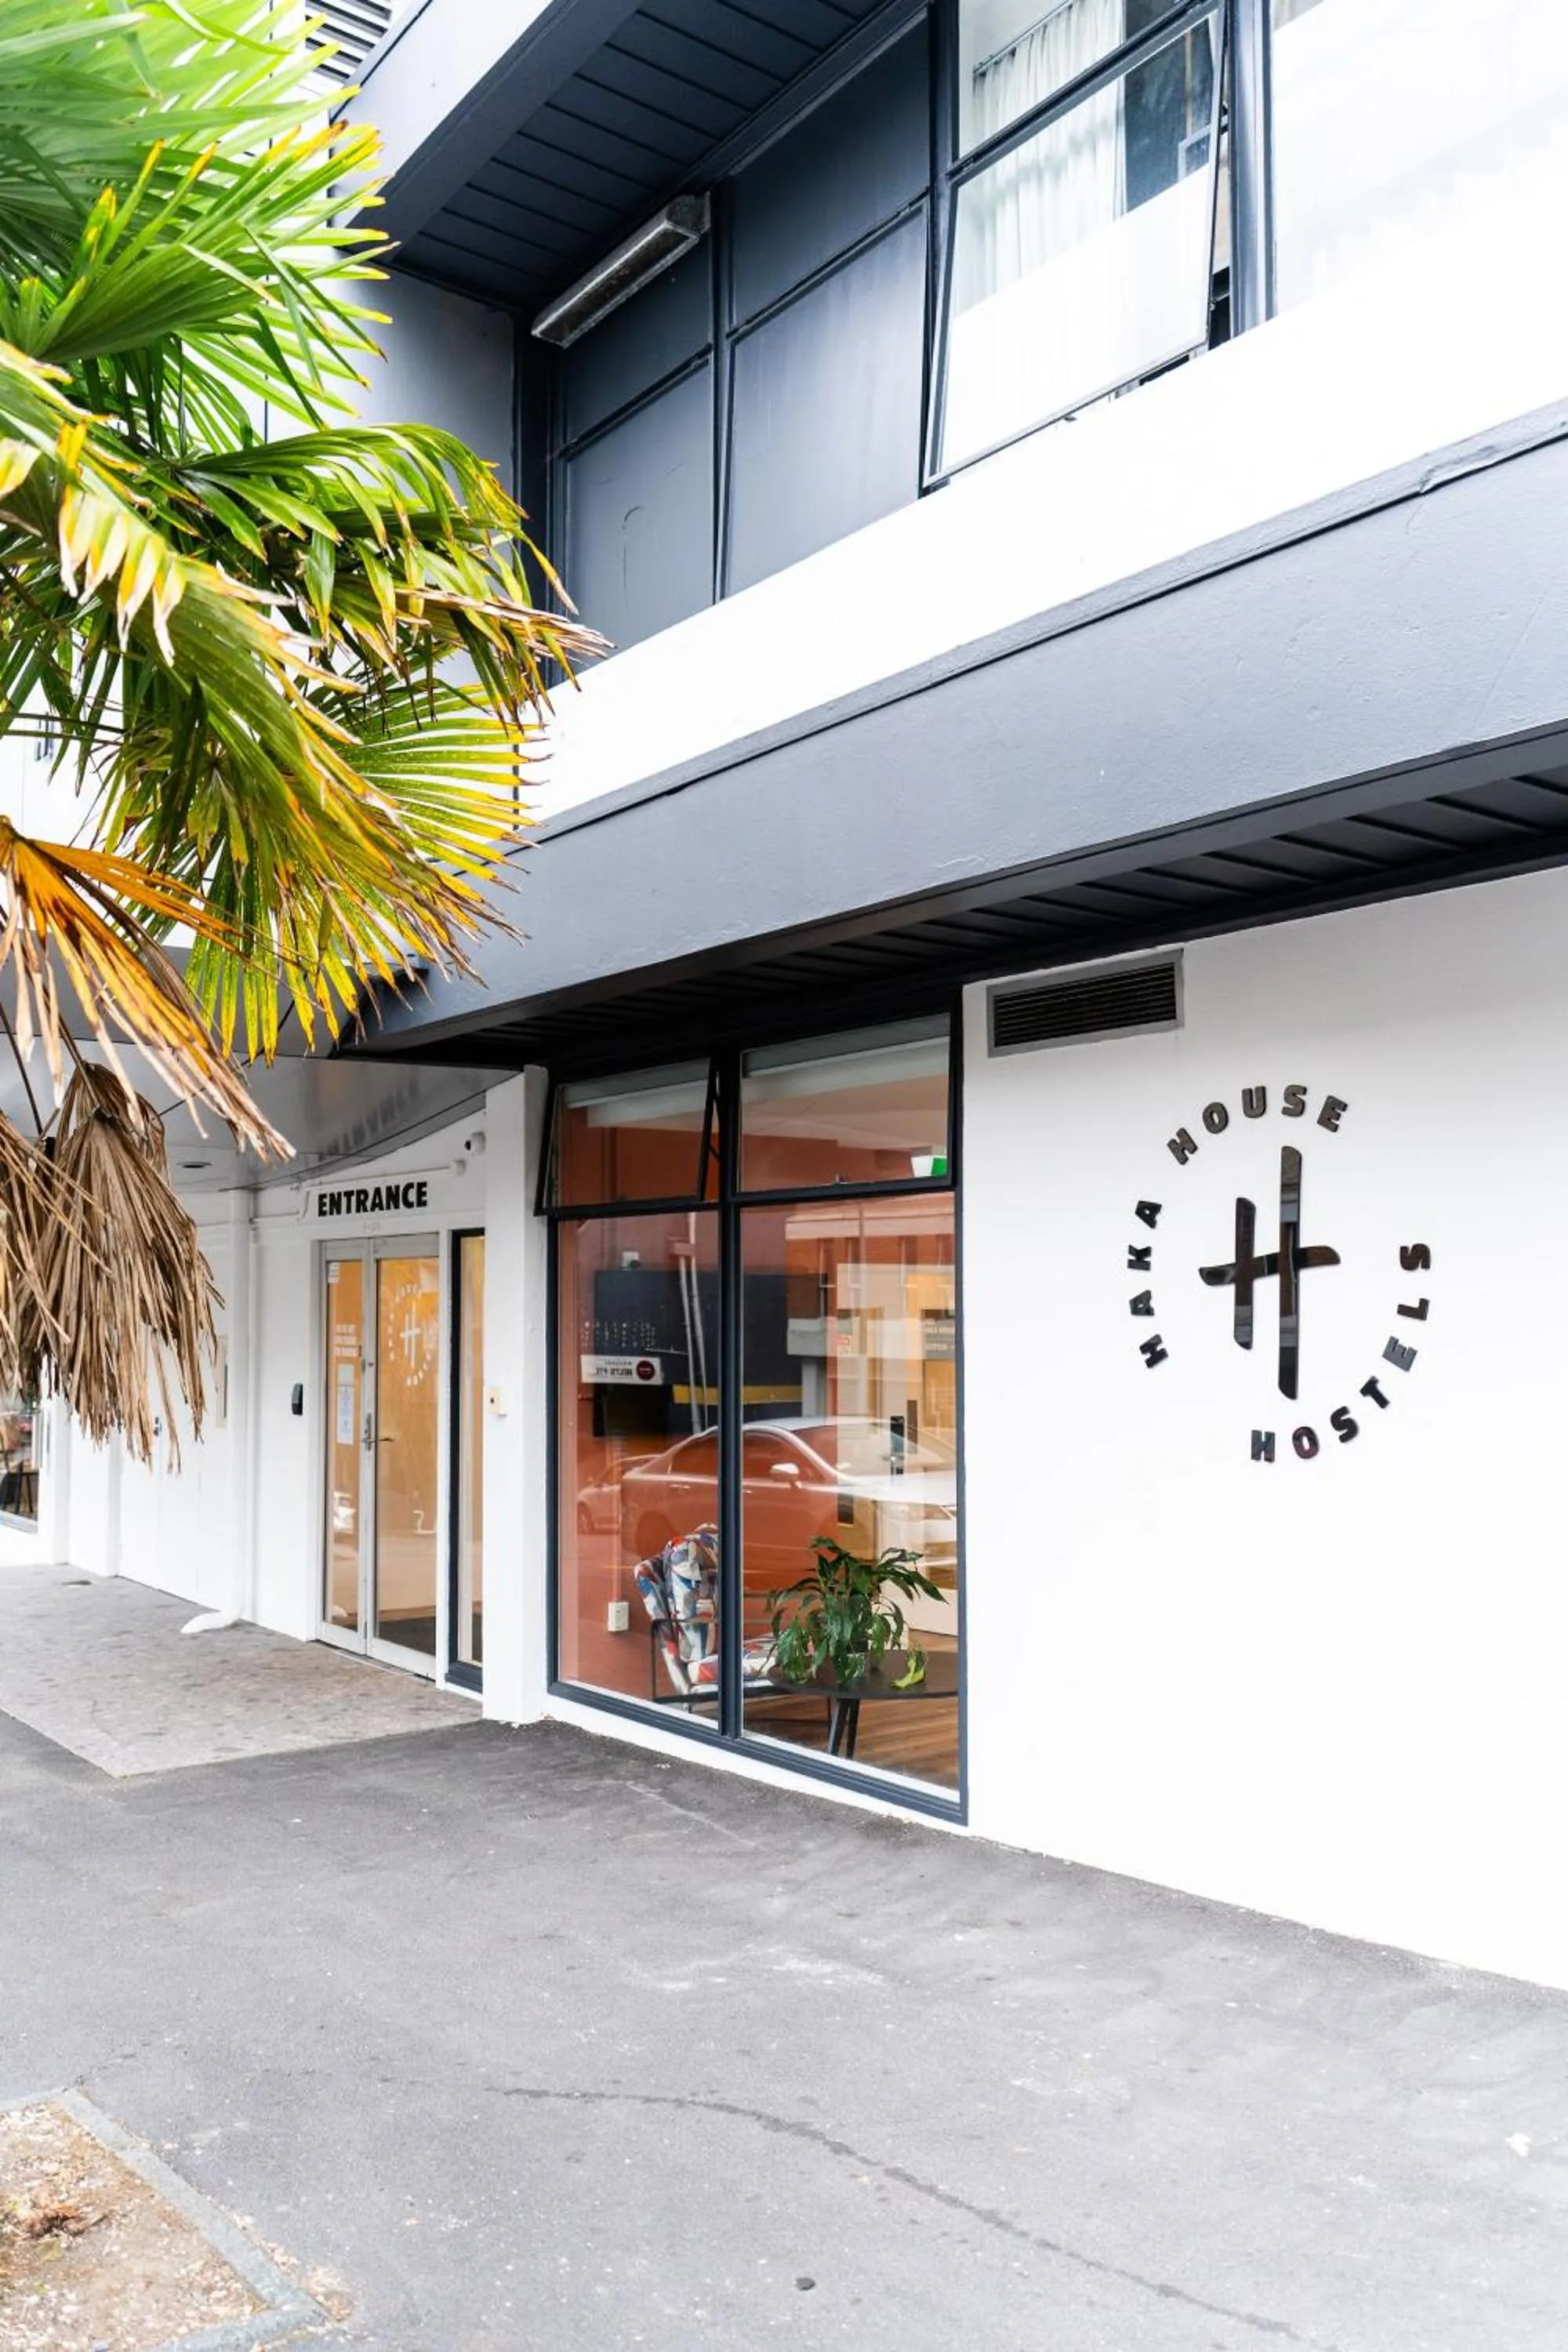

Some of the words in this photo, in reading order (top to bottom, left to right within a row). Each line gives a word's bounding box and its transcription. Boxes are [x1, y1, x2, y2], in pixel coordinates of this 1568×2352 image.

[318, 1181, 428, 1218] ENTRANCE
[1127, 1201, 1168, 1369] HAKA
[1167, 1084, 1348, 1166] HOUSE
[1250, 1243, 1431, 1463] HOSTELS
